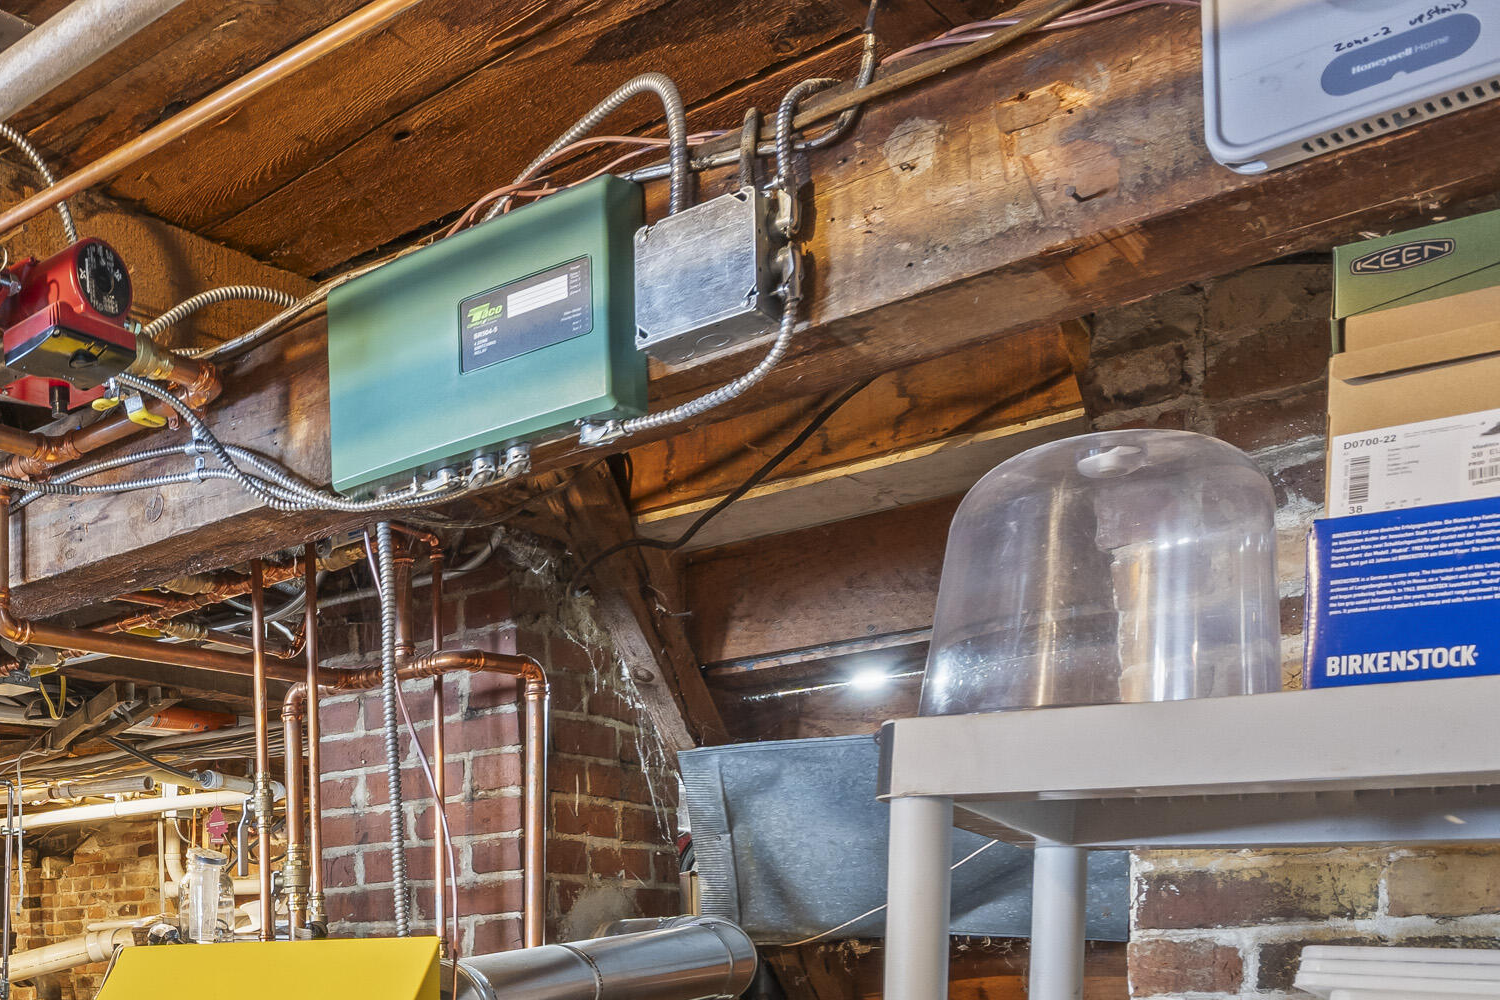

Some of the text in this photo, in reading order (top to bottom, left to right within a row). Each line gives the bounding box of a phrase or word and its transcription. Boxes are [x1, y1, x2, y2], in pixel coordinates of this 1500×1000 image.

[1351, 35, 1450, 75] Honeywell Home
[1355, 240, 1452, 271] KEEN
[467, 302, 503, 323] Taco
[1343, 434, 1397, 450] D0700-22
[1349, 505, 1363, 515] 38
[1326, 644, 1476, 677] BIRKENSTOCK
